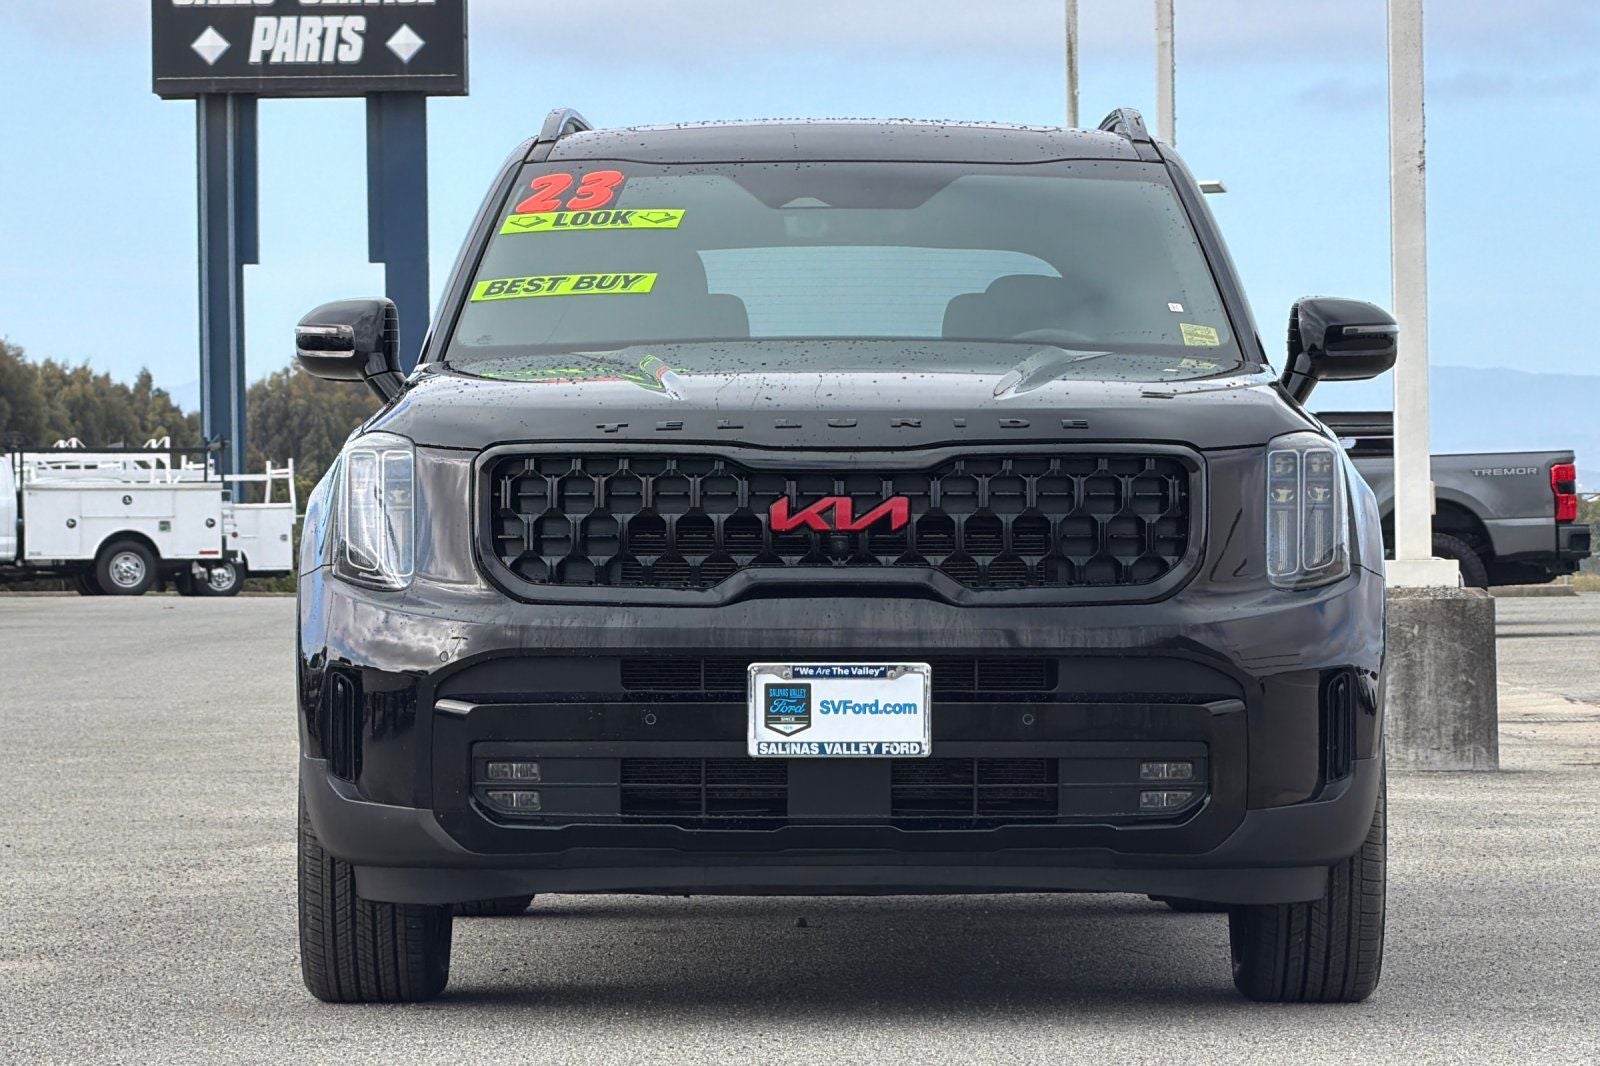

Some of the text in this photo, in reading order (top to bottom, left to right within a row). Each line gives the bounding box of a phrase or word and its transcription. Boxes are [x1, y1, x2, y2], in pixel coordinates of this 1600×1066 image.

[249, 16, 367, 64] PARTS
[516, 170, 625, 214] 23
[551, 211, 635, 228] LOOK
[482, 274, 646, 297] BEST BUY
[595, 418, 1089, 433] TELLURIDE
[1471, 467, 1537, 476] TREMOR
[769, 495, 911, 532] KIA
[794, 667, 885, 677] "We Are The Valley"
[769, 688, 807, 698] SALINAS VALLEY
[769, 698, 807, 714] Ford
[819, 699, 918, 715] SVFord.com
[759, 743, 920, 755] SALINAS VALLEY FORD
